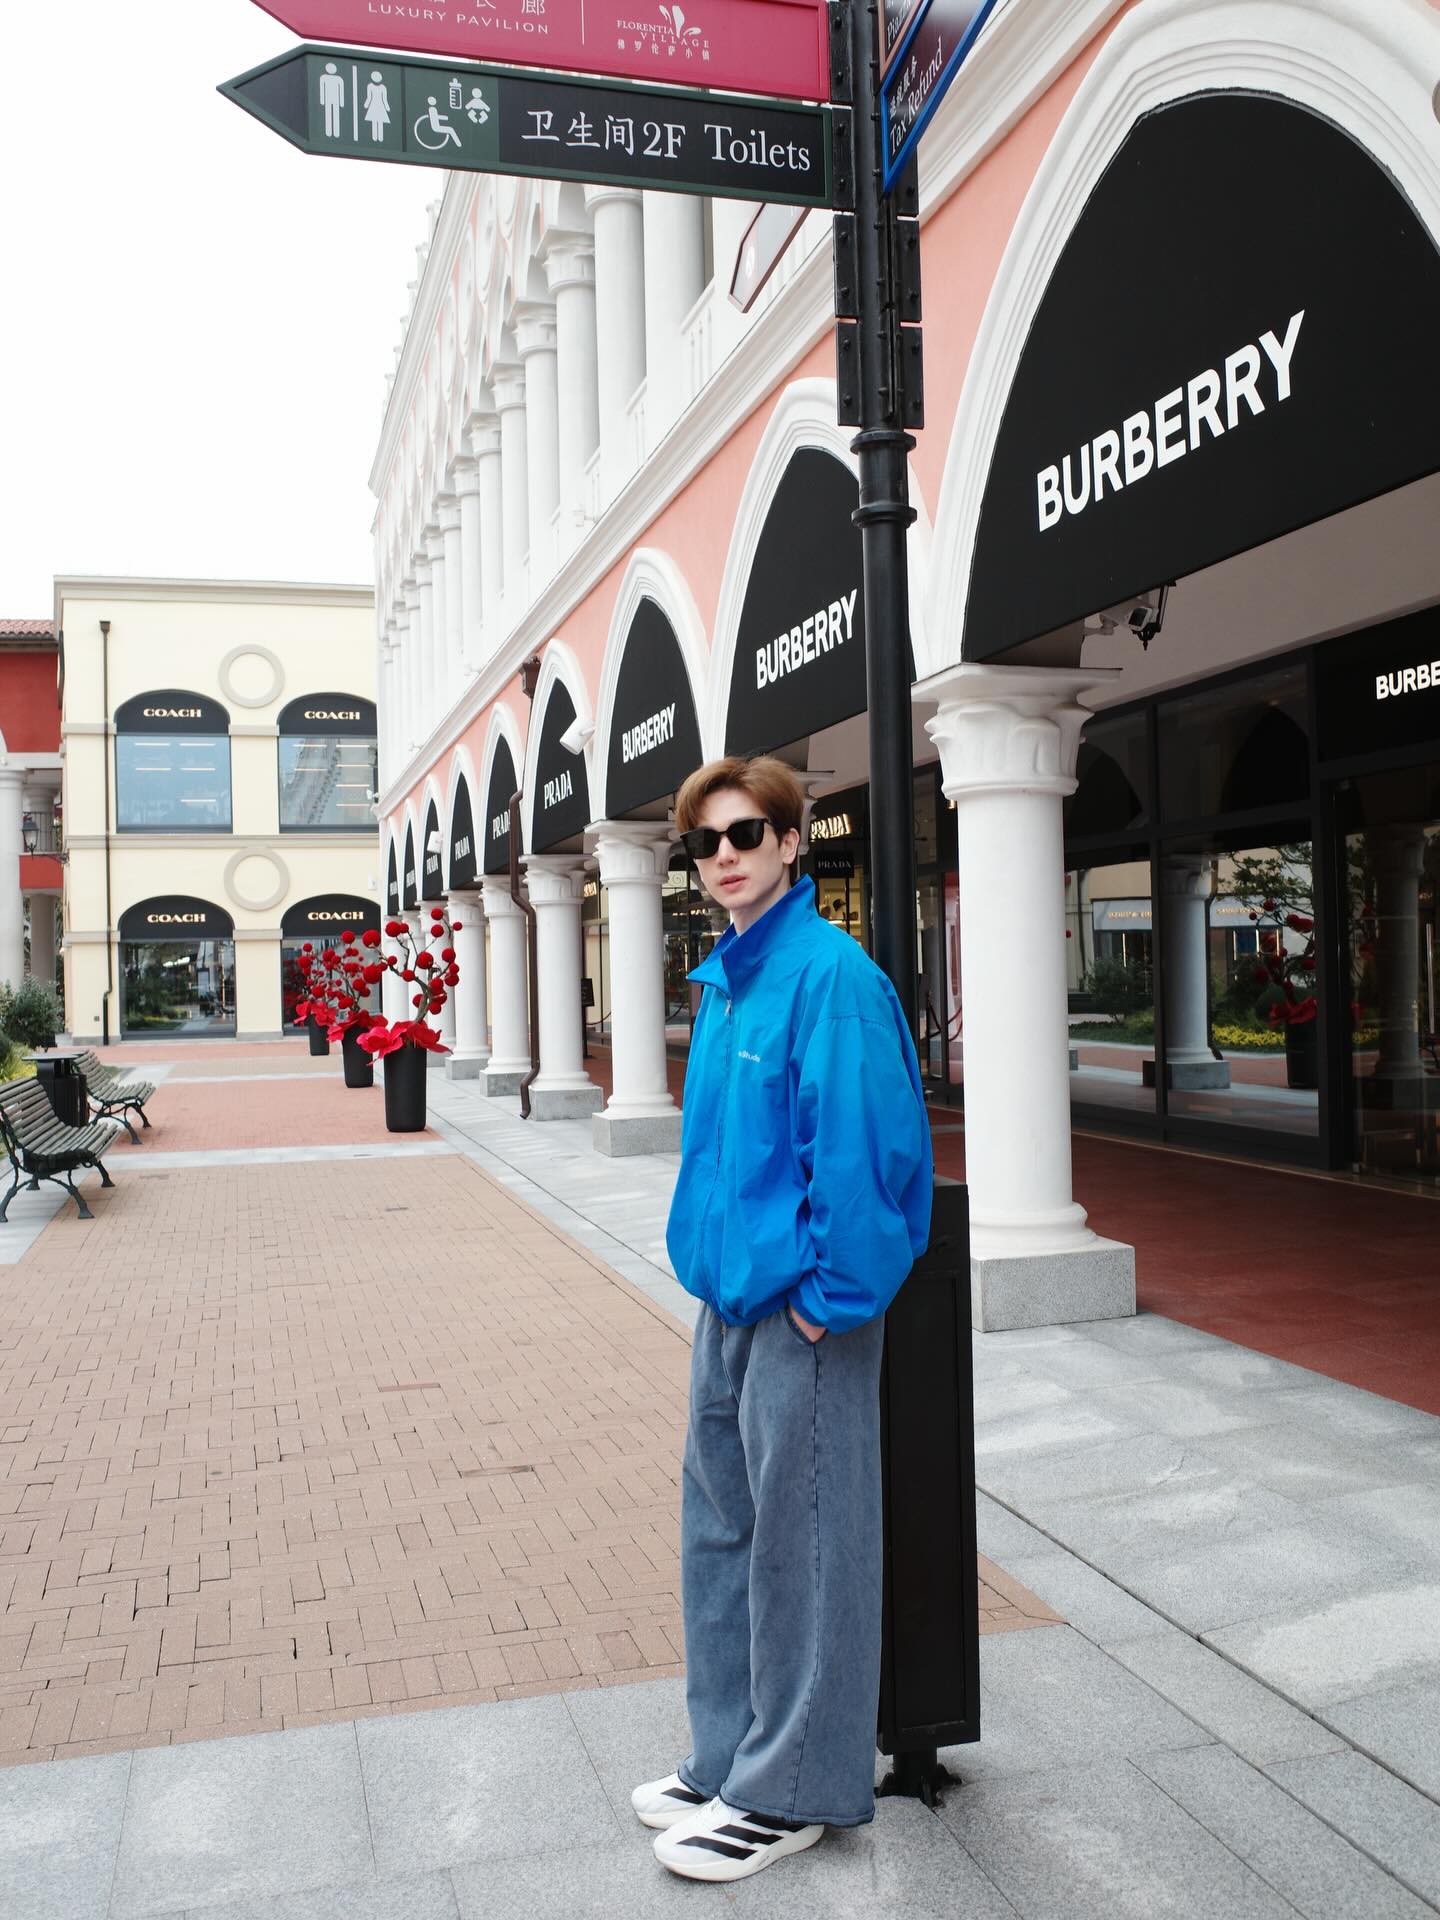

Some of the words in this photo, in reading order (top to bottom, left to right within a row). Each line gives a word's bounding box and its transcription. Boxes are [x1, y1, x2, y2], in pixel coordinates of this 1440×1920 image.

[368, 2, 447, 21] LUXURY
[456, 13, 548, 34] PAVILION
[617, 20, 674, 35] FLORENTIA
[641, 32, 709, 49] VILLAGE
[890, 114, 907, 157] Tax
[908, 35, 943, 125] Refund
[704, 123, 811, 171] Toilets
[1037, 309, 1305, 532] BURBERRY
[756, 588, 858, 690] BURBERRY
[143, 708, 202, 718] COACH
[304, 711, 361, 720] COACH
[622, 702, 676, 763] BURBERRY
[543, 769, 573, 810] PRADA
[492, 808, 511, 841] PRAD
[811, 813, 850, 843] PRADA
[817, 861, 852, 869] PRADA
[147, 913, 206, 923] COACH
[307, 911, 364, 921] COACH
